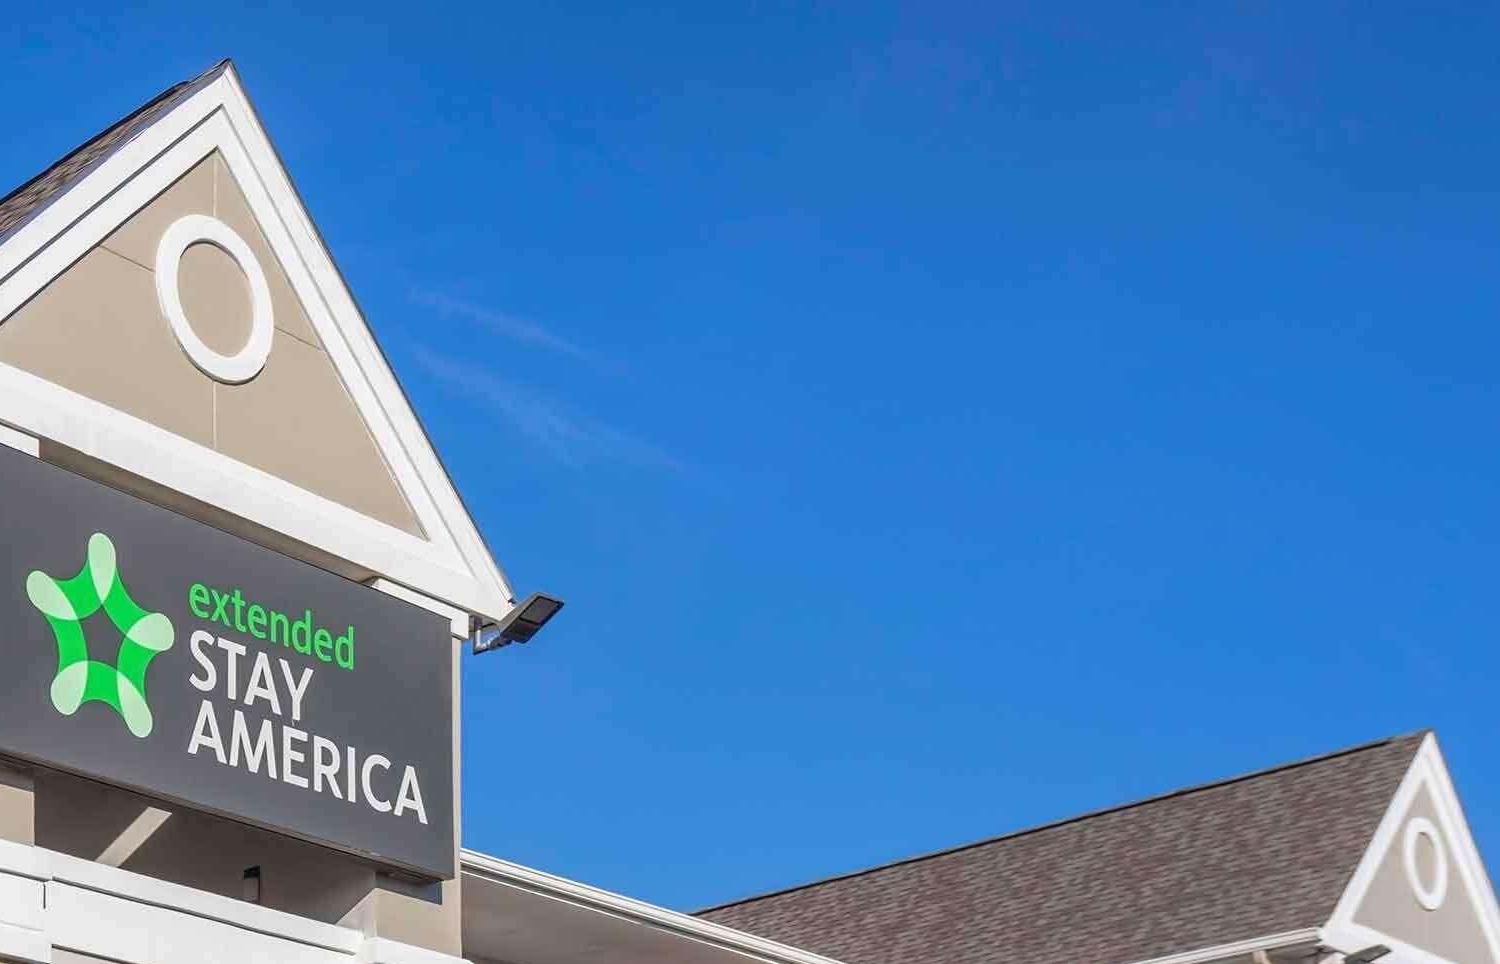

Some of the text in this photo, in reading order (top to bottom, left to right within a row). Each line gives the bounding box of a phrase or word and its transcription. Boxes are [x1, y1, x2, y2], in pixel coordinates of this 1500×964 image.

[188, 582, 355, 671] extended
[188, 629, 314, 722] STAY
[187, 699, 429, 825] AMERICA
